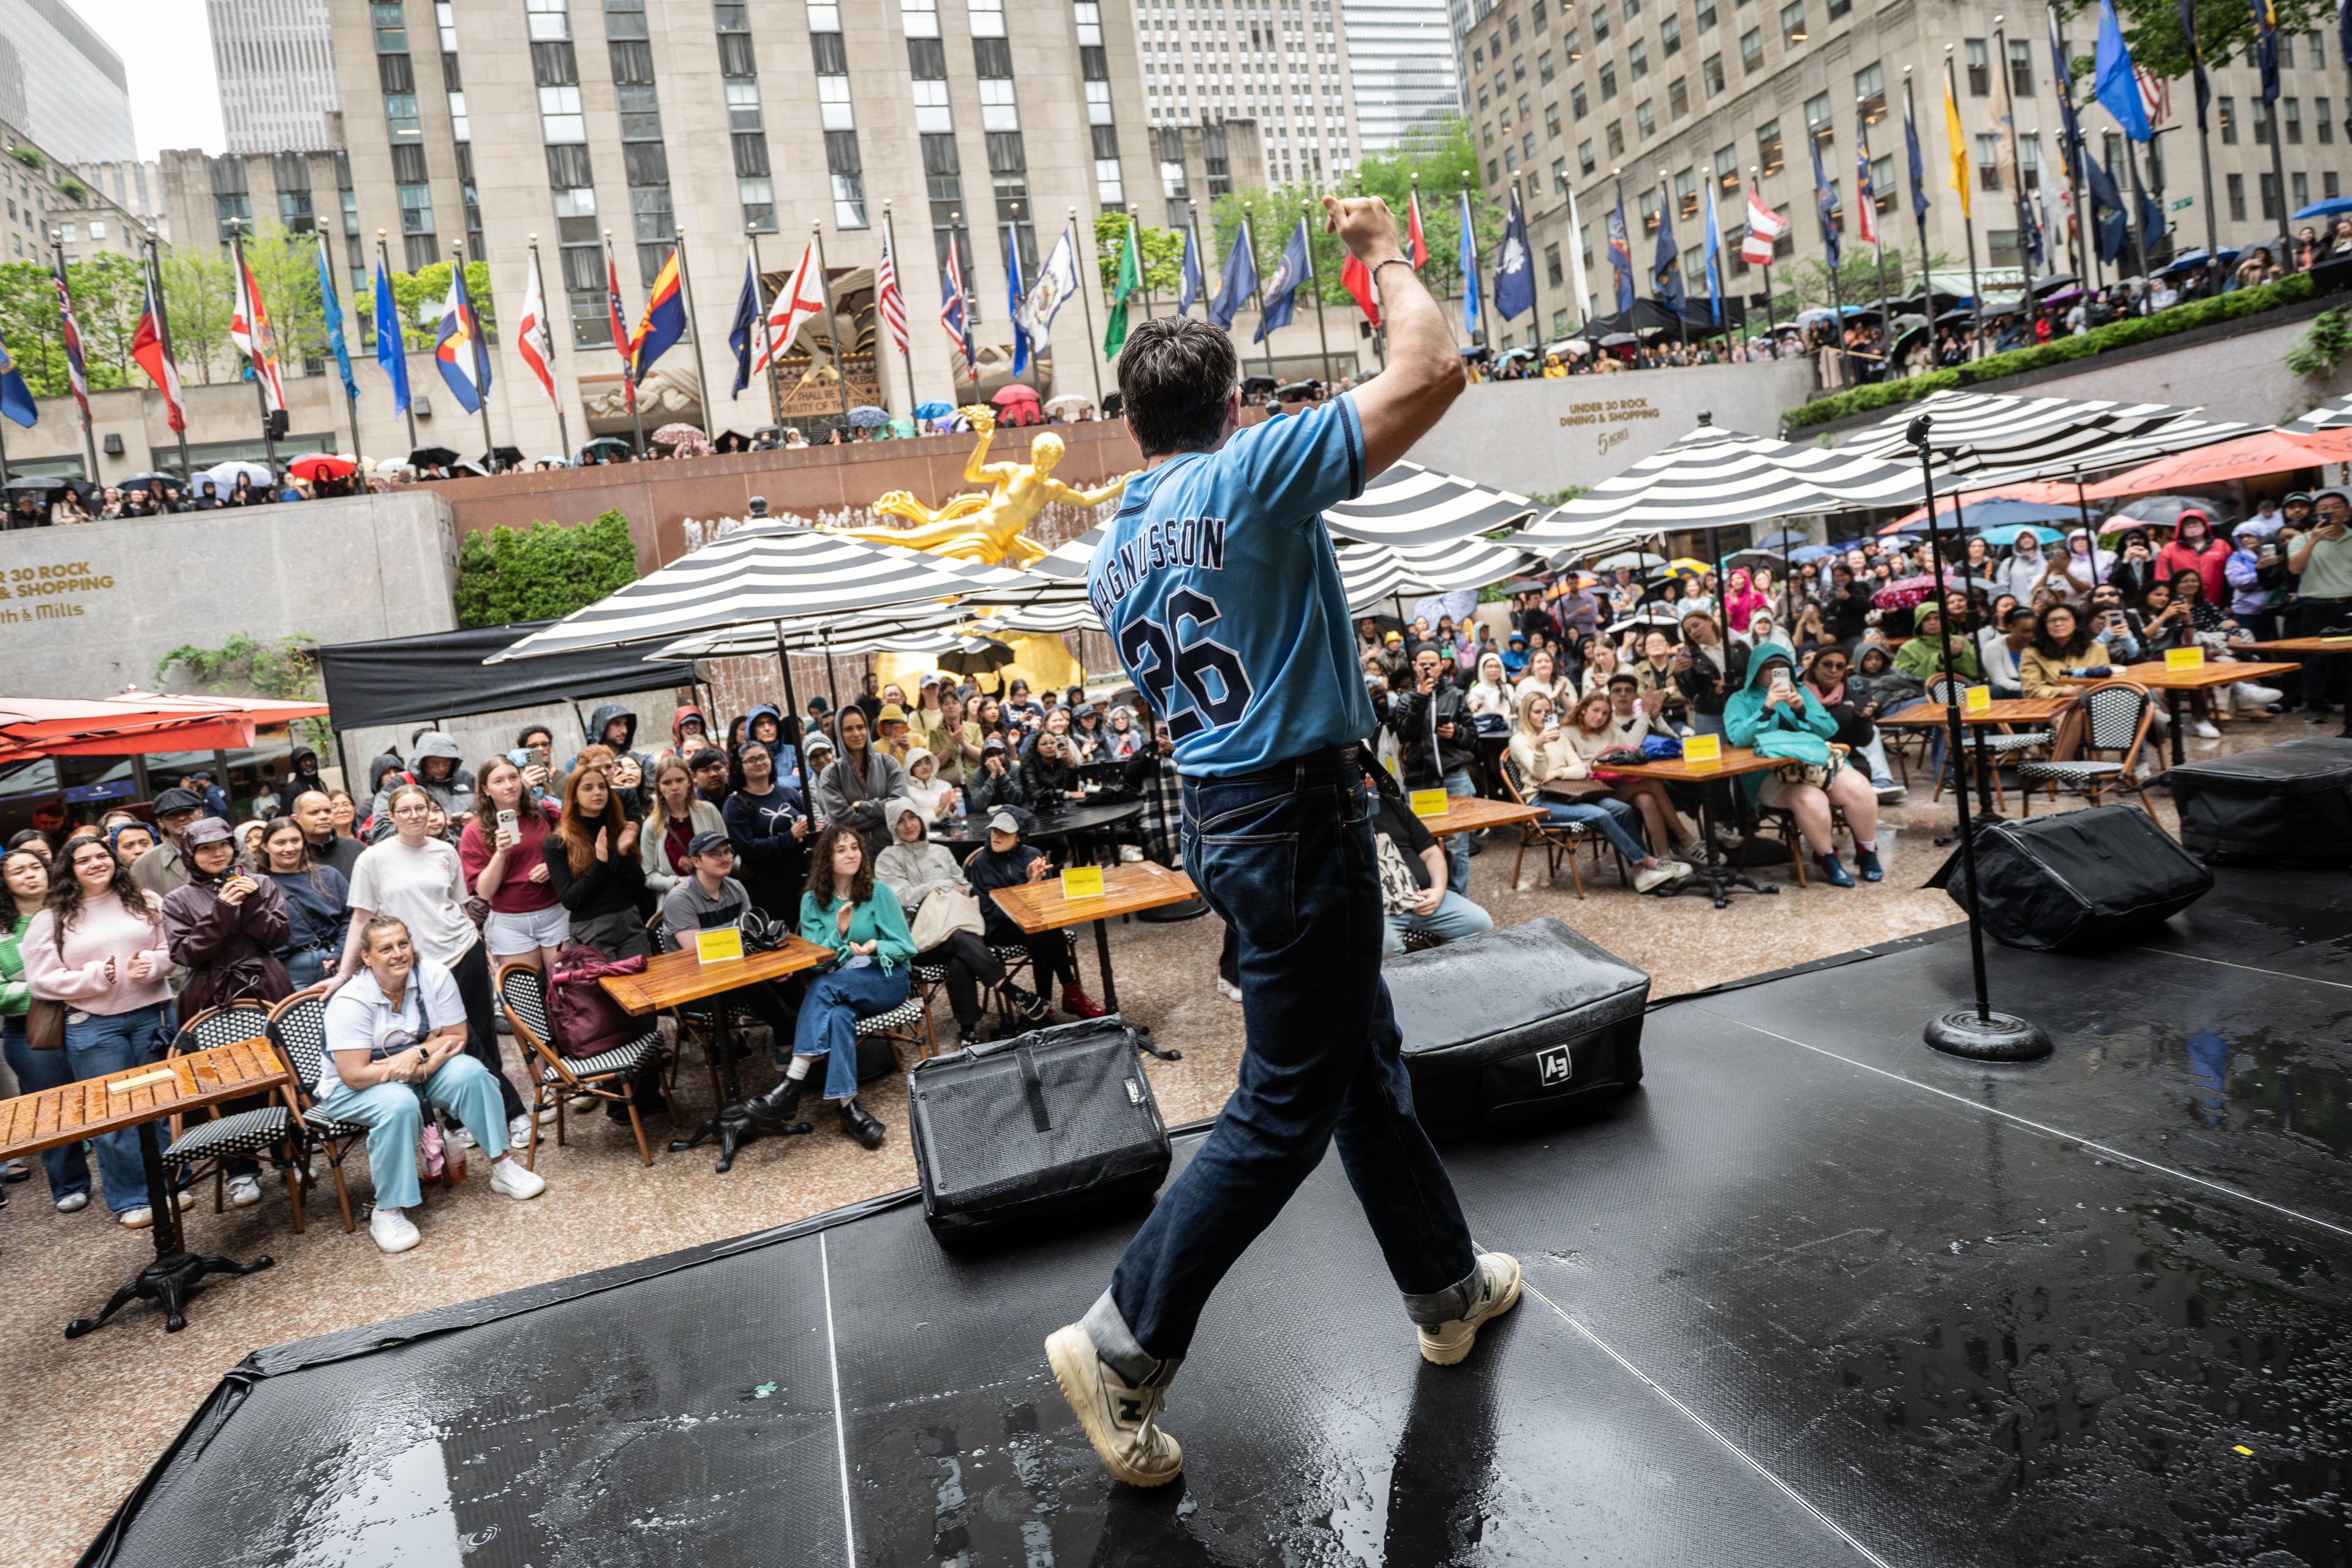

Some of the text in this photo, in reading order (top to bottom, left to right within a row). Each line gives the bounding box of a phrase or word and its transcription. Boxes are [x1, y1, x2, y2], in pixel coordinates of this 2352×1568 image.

[824, 388, 835, 399] BE
[815, 401, 829, 411] OF
[1569, 398, 1648, 414] UNDER 30 ROCK
[1559, 408, 1660, 427] DINING & SHOPPING
[1598, 428, 1630, 456] 5 ACRES
[10, 568, 35, 582] 30
[38, 561, 91, 579] ROCK
[17, 575, 115, 598] SHOPPING
[22, 608, 32, 622] &
[36, 602, 85, 620] Mills
[1118, 584, 1255, 745] 26
[703, 938, 735, 948] Reserved
